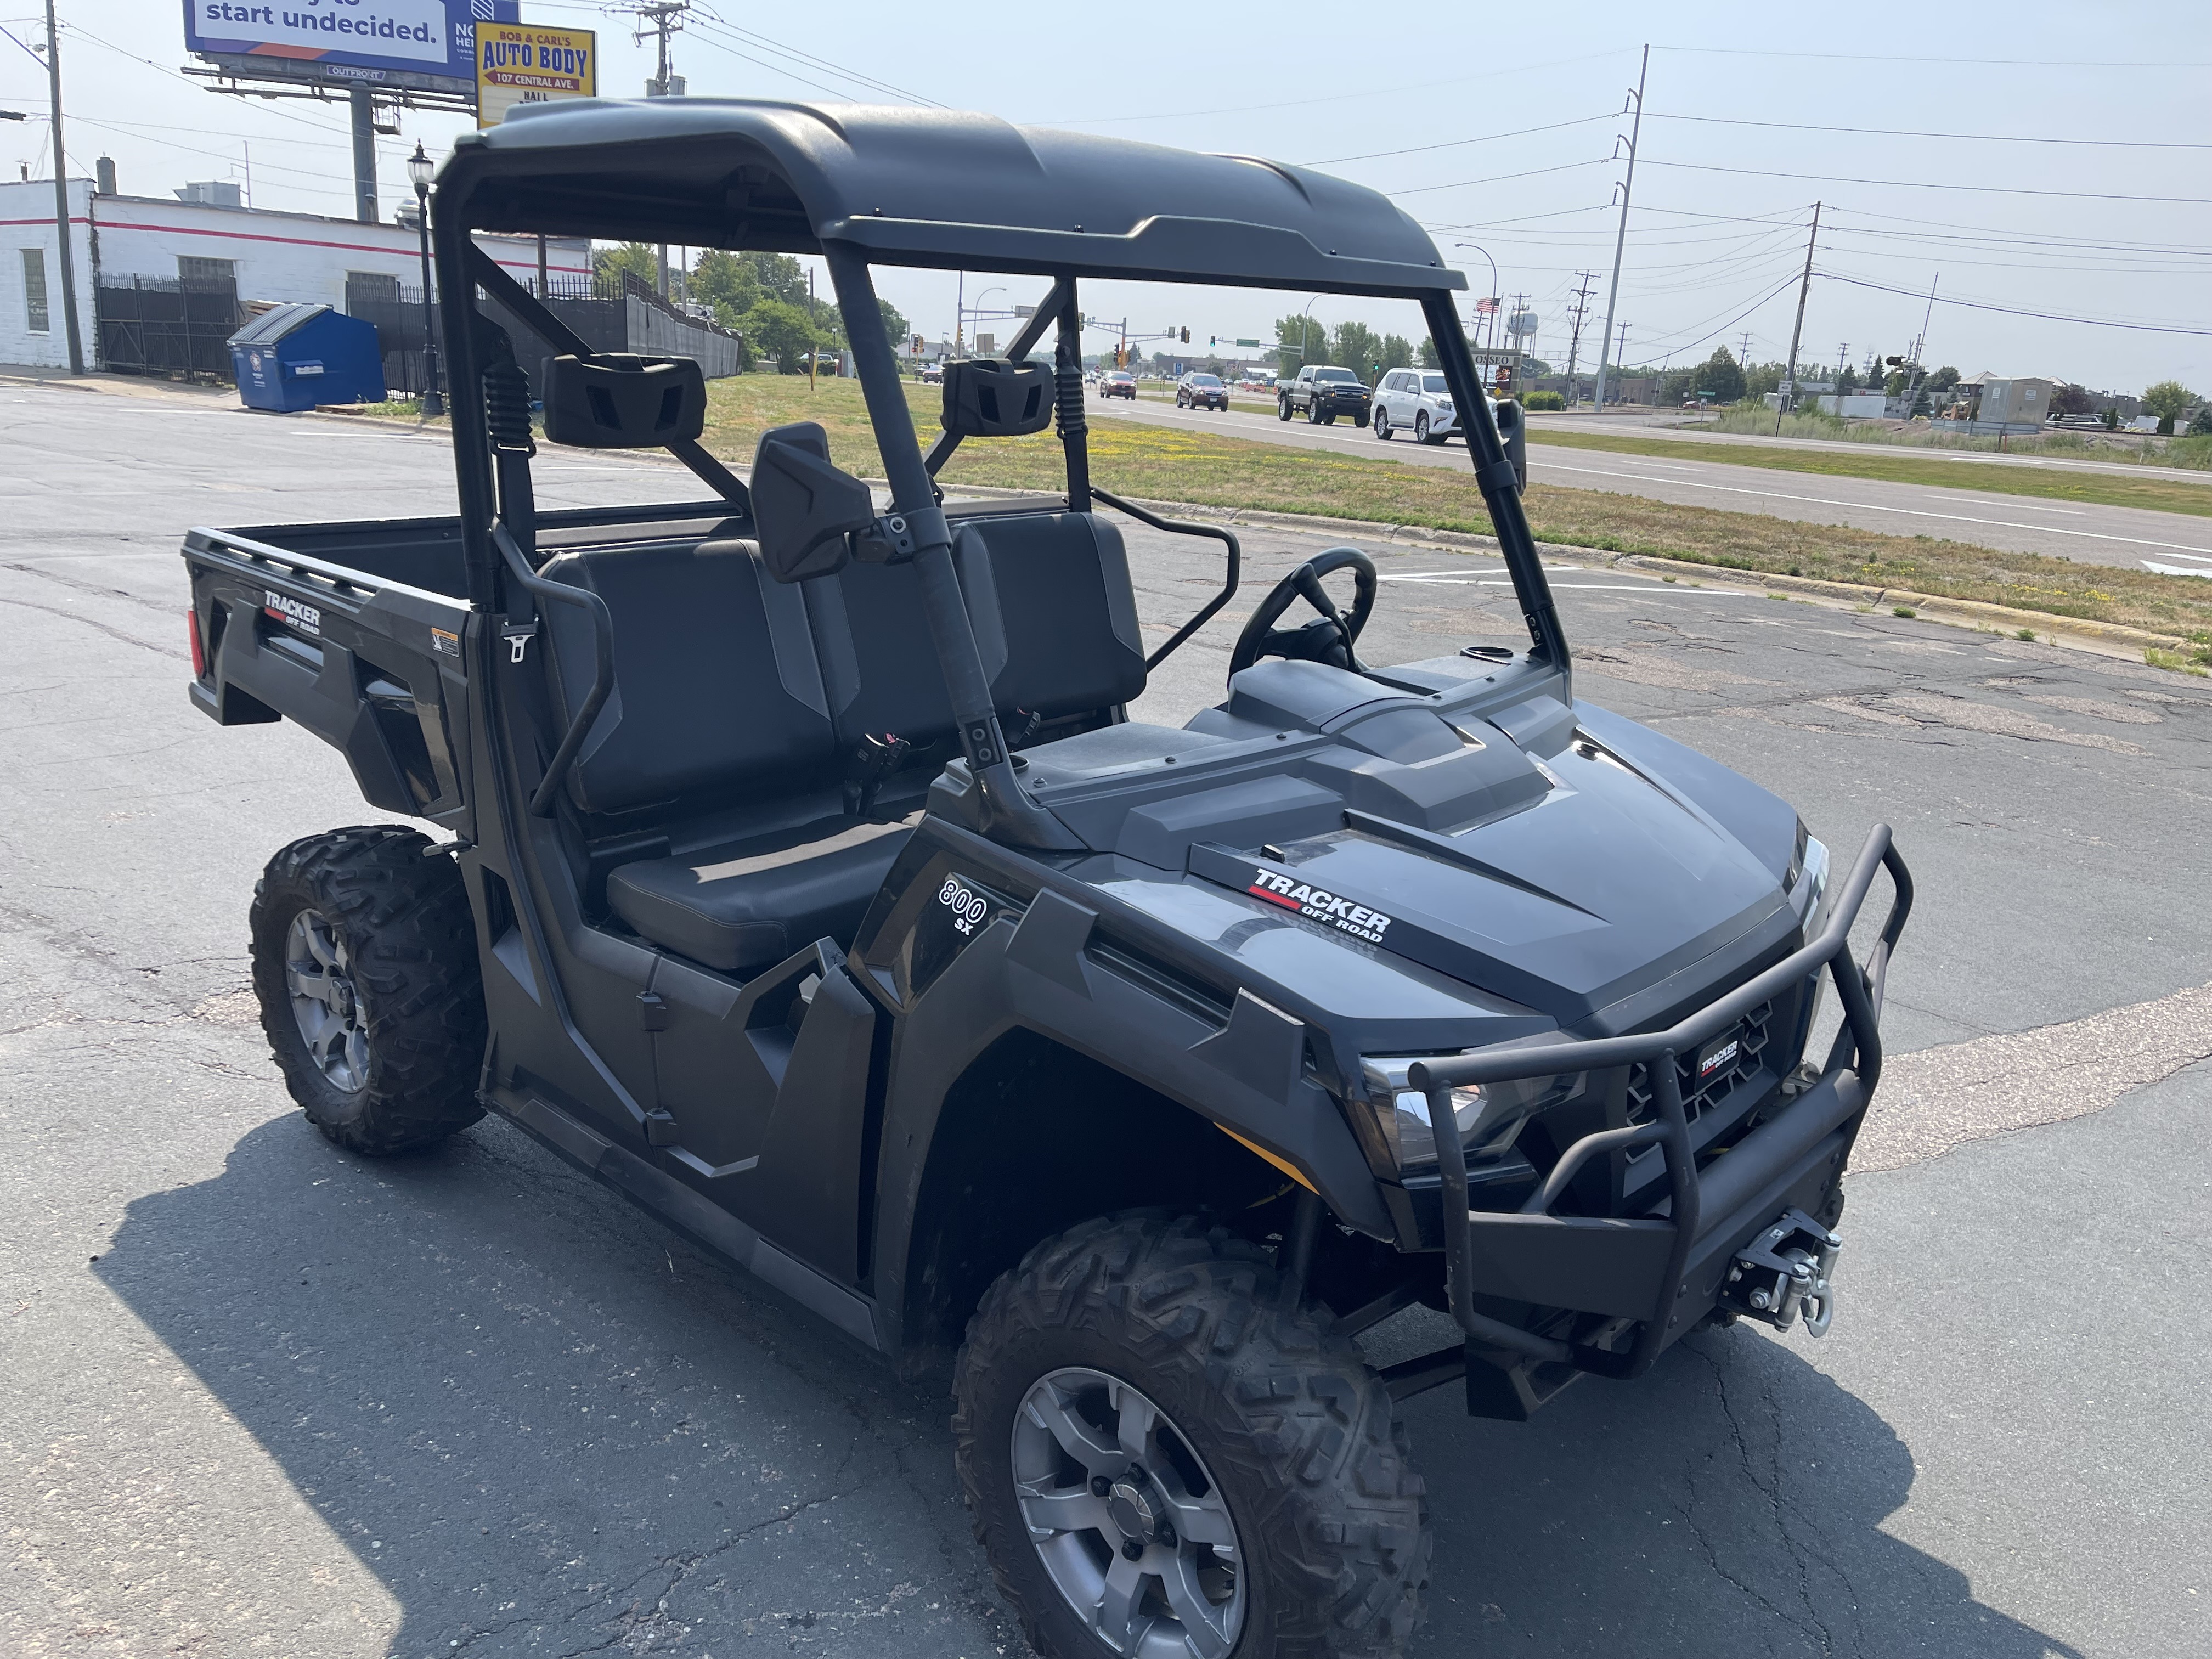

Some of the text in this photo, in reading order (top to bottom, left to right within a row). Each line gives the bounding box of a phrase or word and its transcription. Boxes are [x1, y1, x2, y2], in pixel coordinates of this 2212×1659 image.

[207, 2, 437, 43] start undecided.
[500, 31, 571, 46] BOB & CARL'S
[332, 67, 380, 78] OUTFRONT
[483, 41, 587, 78] AUTO BODY
[496, 73, 574, 89] 107 CENTRAL AVE.
[1475, 355, 1509, 365] OSSEO
[264, 590, 320, 626] TRACKER
[286, 616, 300, 627] OFF
[939, 879, 987, 923] 800
[1254, 868, 1391, 933] TRACKER
[954, 918, 974, 936] SX
[1301, 906, 1383, 943] OFF ROAD
[1702, 1040, 1738, 1072] TRACKER
